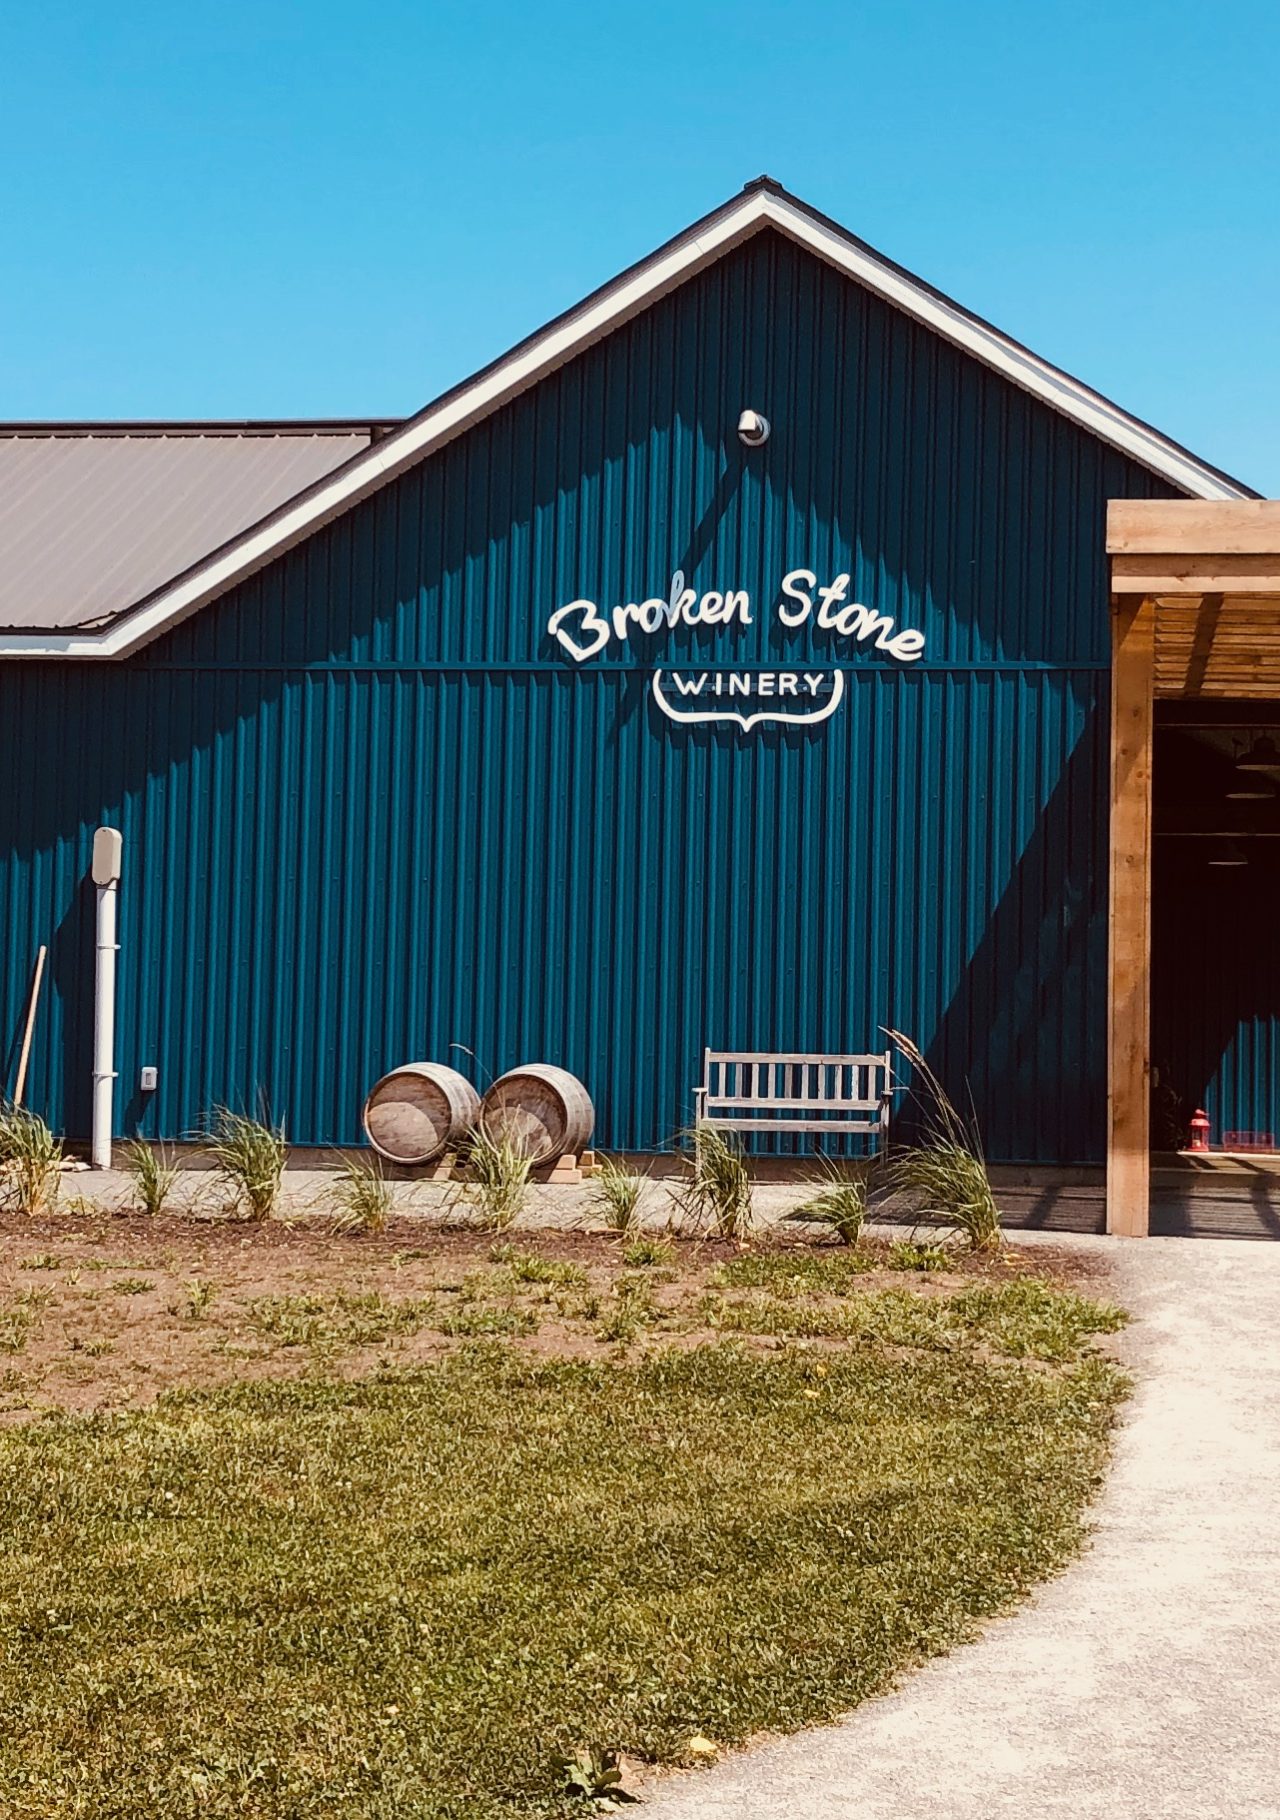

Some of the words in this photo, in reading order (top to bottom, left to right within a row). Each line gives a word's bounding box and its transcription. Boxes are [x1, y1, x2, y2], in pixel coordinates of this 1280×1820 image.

[548, 570, 752, 661] Broken
[779, 569, 925, 661] Stone
[673, 672, 825, 696] WINERY
